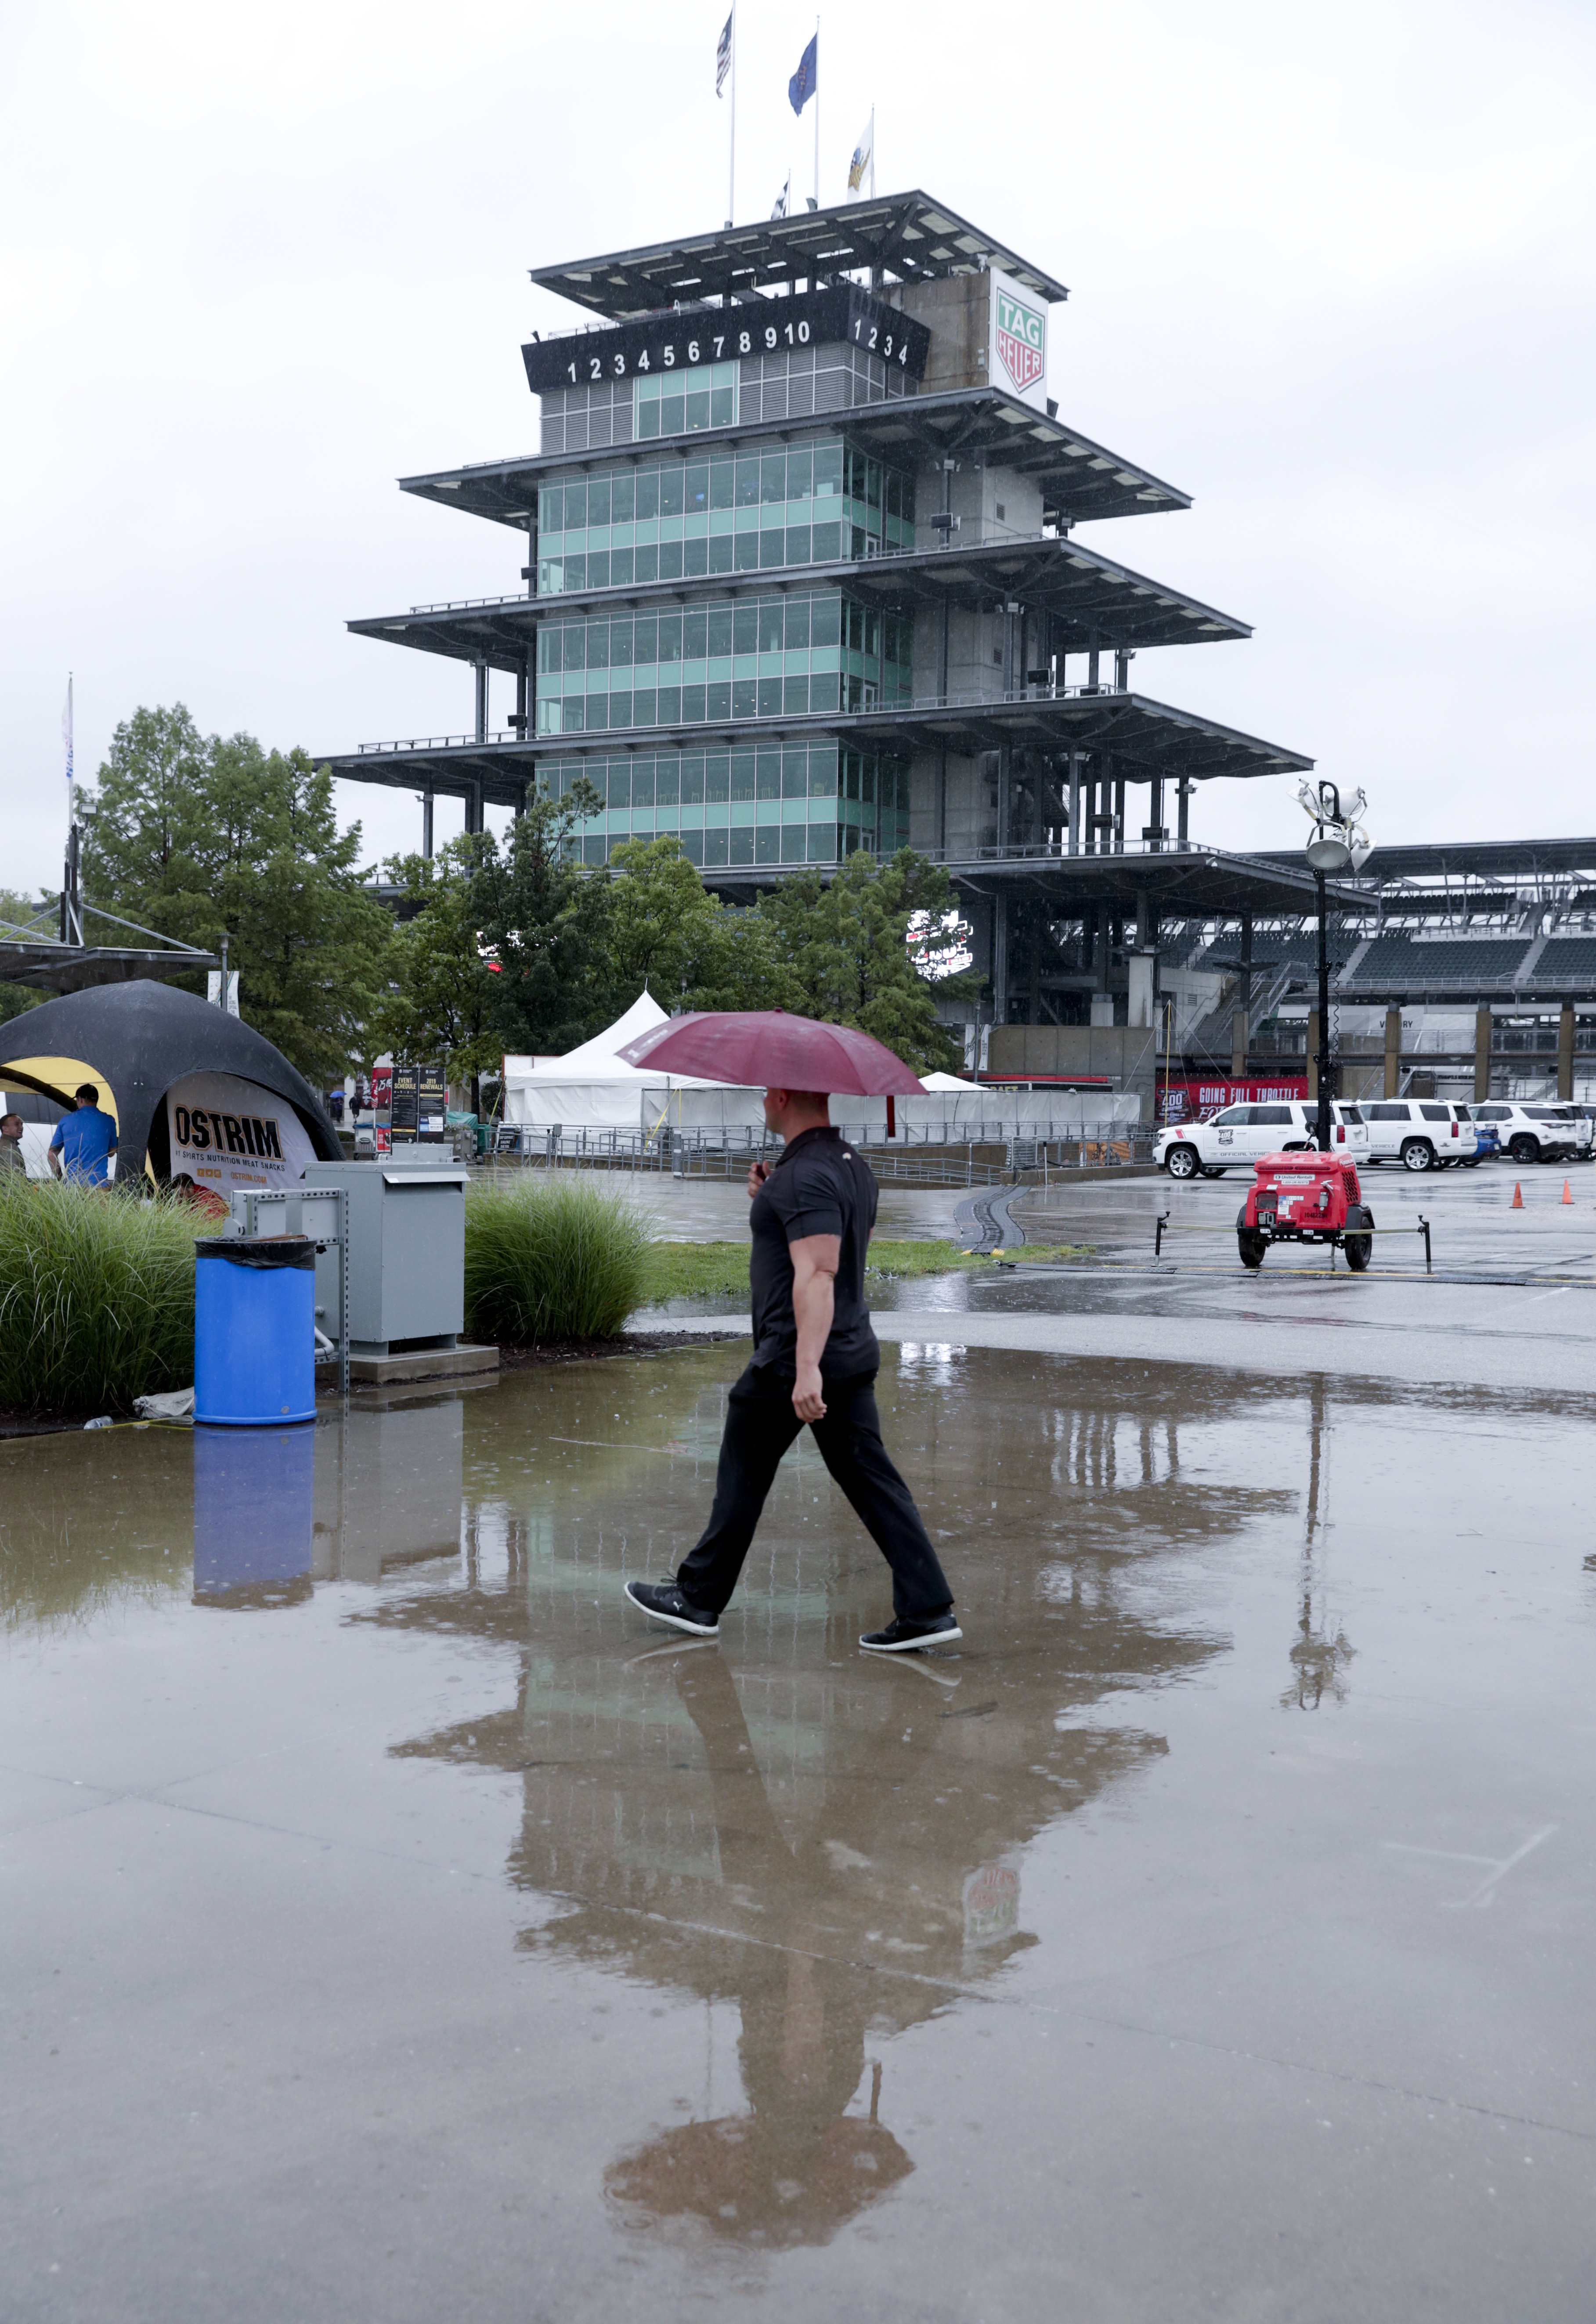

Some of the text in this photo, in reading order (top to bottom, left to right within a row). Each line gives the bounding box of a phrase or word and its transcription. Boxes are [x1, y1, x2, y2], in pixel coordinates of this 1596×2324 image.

[855, 319, 907, 365] 1 2 3 4
[1001, 298, 1039, 346] TAG
[568, 321, 809, 383] 1 2 3 4 5 6 7 8 9 10
[999, 332, 1040, 384] HEUER
[1199, 1087, 1299, 1103] GOING FULL THROTTLE
[174, 1104, 283, 1161] OSTRIM
[183, 1151, 204, 1161] SPORTS
[207, 1155, 241, 1165] NUTRITION
[243, 1160, 258, 1168] MEAT
[261, 1162, 285, 1171] SNACKS
[231, 1171, 267, 1184] OSTRIM.COM
